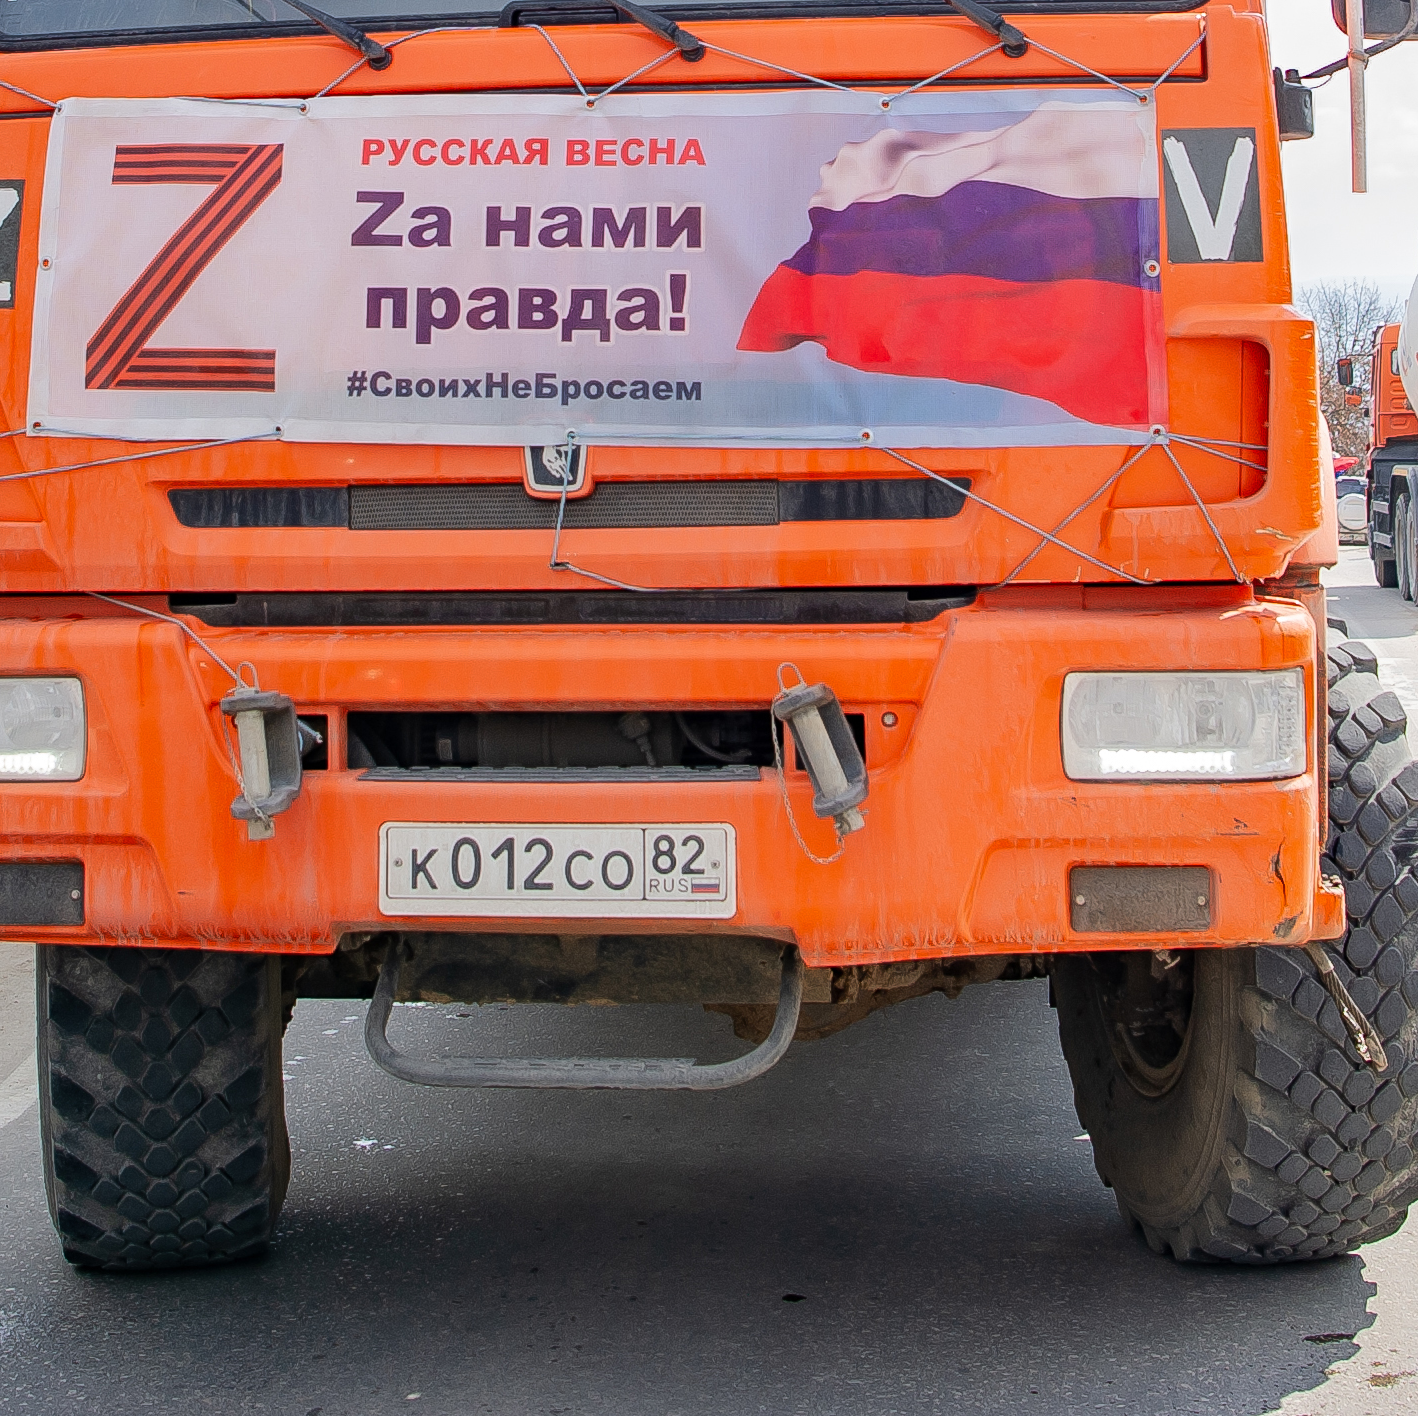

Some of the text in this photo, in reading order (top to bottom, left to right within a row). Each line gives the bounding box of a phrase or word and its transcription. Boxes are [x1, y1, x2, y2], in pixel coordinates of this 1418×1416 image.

[360, 137, 707, 167] РУССКАЯ ВЕСНА
[350, 189, 703, 250] Zа нами
[1162, 135, 1256, 262] V
[84, 142, 285, 393] Z
[364, 272, 688, 345] правда!
[345, 369, 703, 407] #СвоихНеБросаем
[409, 834, 706, 891] К012СО 82
[649, 877, 689, 894] RUS
